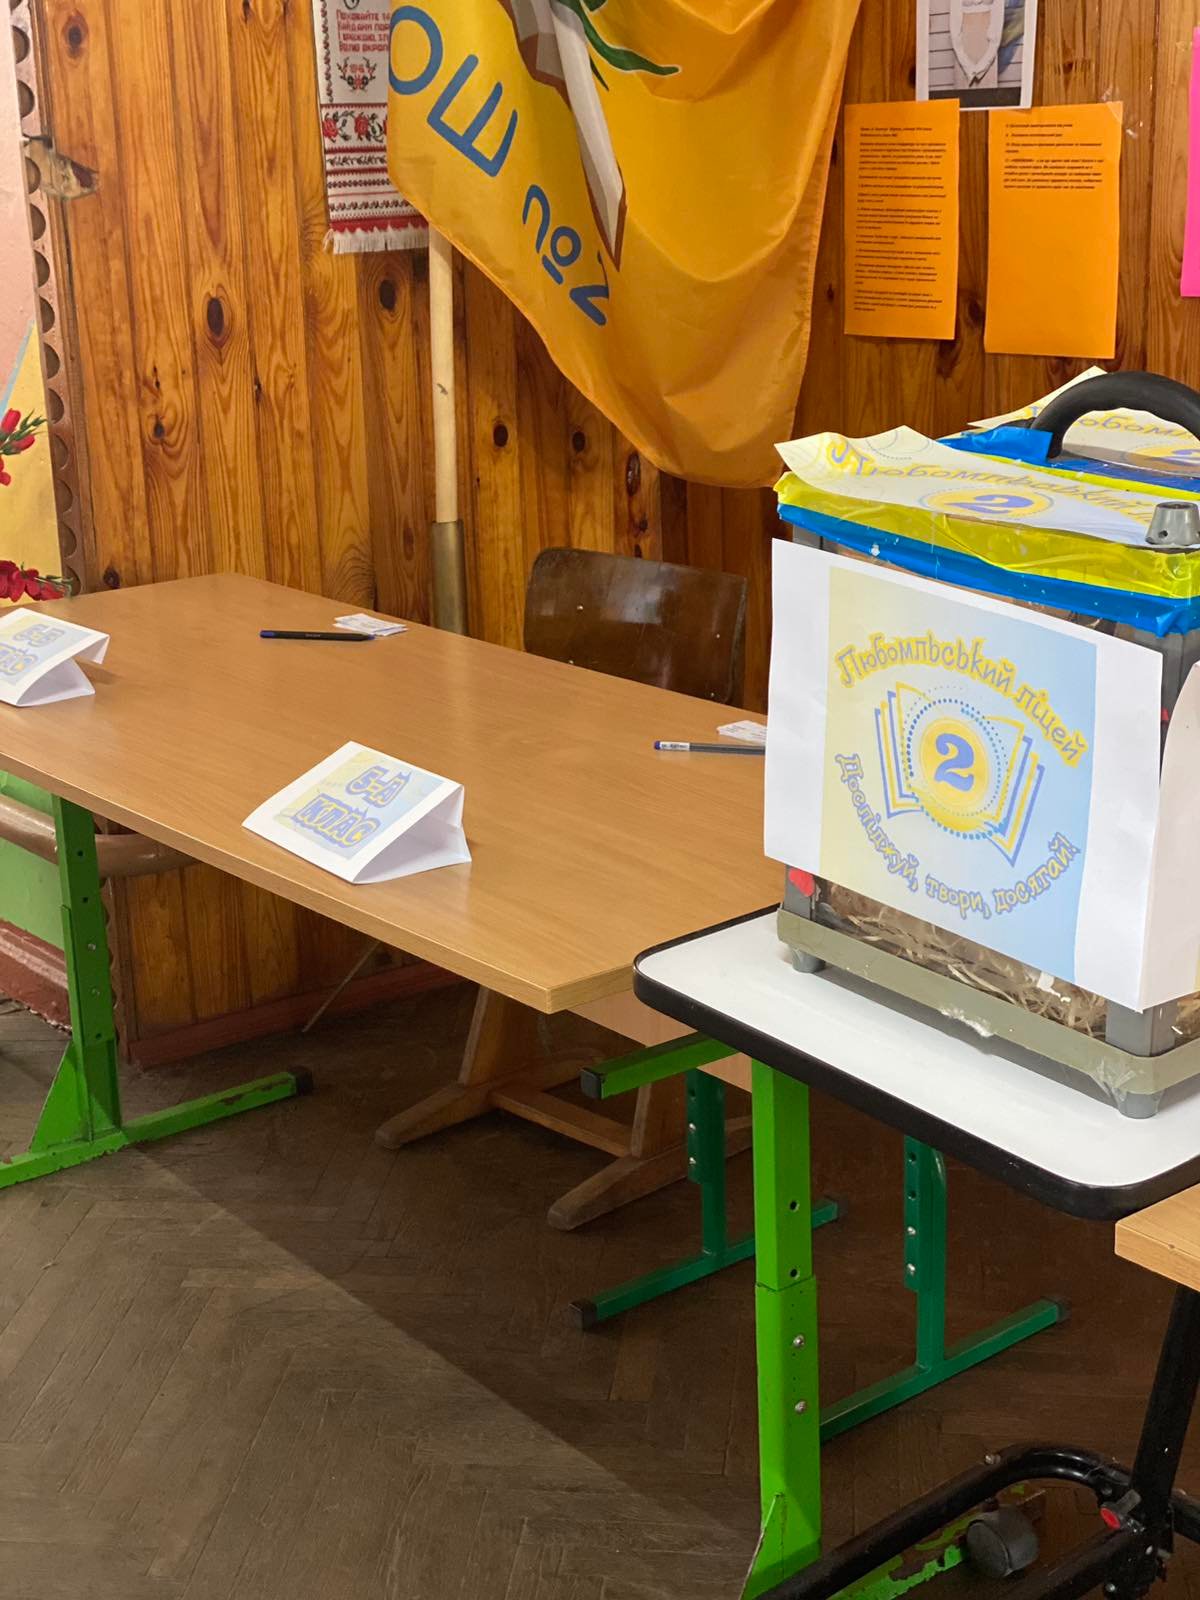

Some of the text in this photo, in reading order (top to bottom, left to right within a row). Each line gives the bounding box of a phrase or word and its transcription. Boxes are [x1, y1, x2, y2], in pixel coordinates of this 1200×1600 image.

[945, 494, 1034, 514] 2
[835, 630, 1088, 767] Любомльський ліцей
[935, 733, 974, 791] 2
[835, 753, 1081, 919] Досліджуй, твори, досягай!
